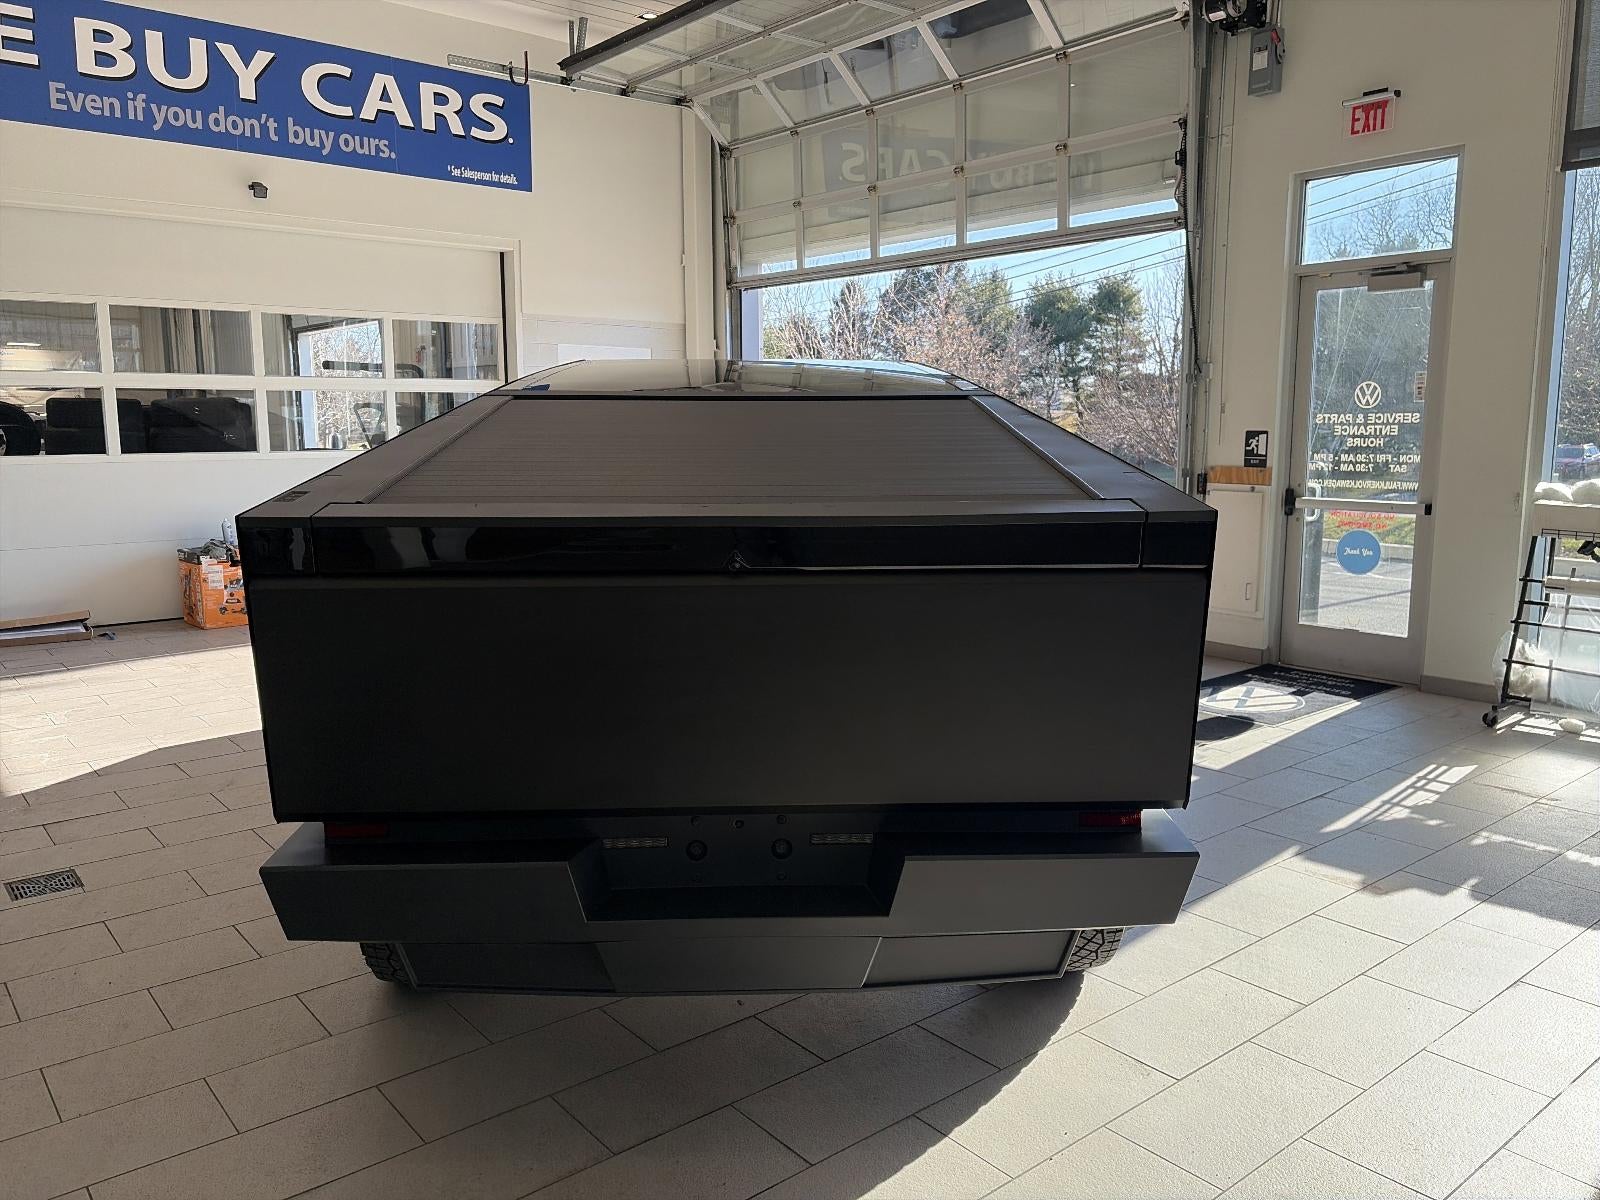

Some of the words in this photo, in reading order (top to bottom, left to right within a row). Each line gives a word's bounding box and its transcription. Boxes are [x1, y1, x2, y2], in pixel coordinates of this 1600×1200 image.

[73, 17, 276, 102] BUY
[300, 63, 514, 144] CARS.
[49, 81, 122, 118] Even
[126, 91, 147, 122] if
[150, 103, 203, 131] you
[208, 106, 279, 142] don't
[287, 117, 335, 156] buy
[338, 133, 397, 160] ours.
[1350, 99, 1390, 136] EXIT
[461, 166, 492, 182] Salesperson
[491, 170, 500, 182] for
[500, 172, 518, 185] details.
